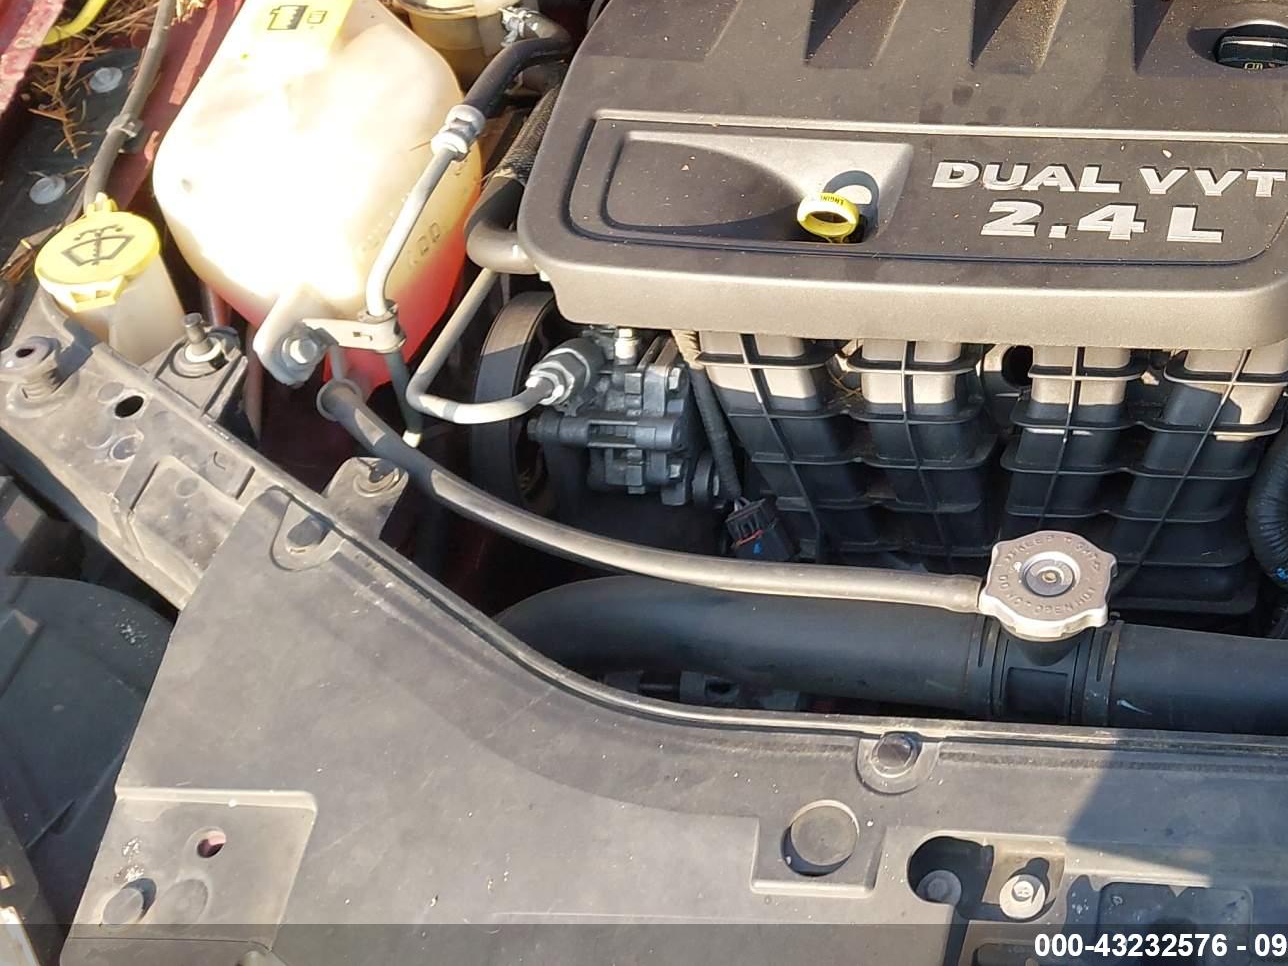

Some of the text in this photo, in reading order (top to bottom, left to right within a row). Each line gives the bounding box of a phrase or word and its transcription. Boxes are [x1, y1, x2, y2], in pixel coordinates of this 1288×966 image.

[931, 161, 1288, 197] DUAL VVT
[980, 198, 1224, 243] 2.4 L
[1034, 603, 1074, 615] OPEN
